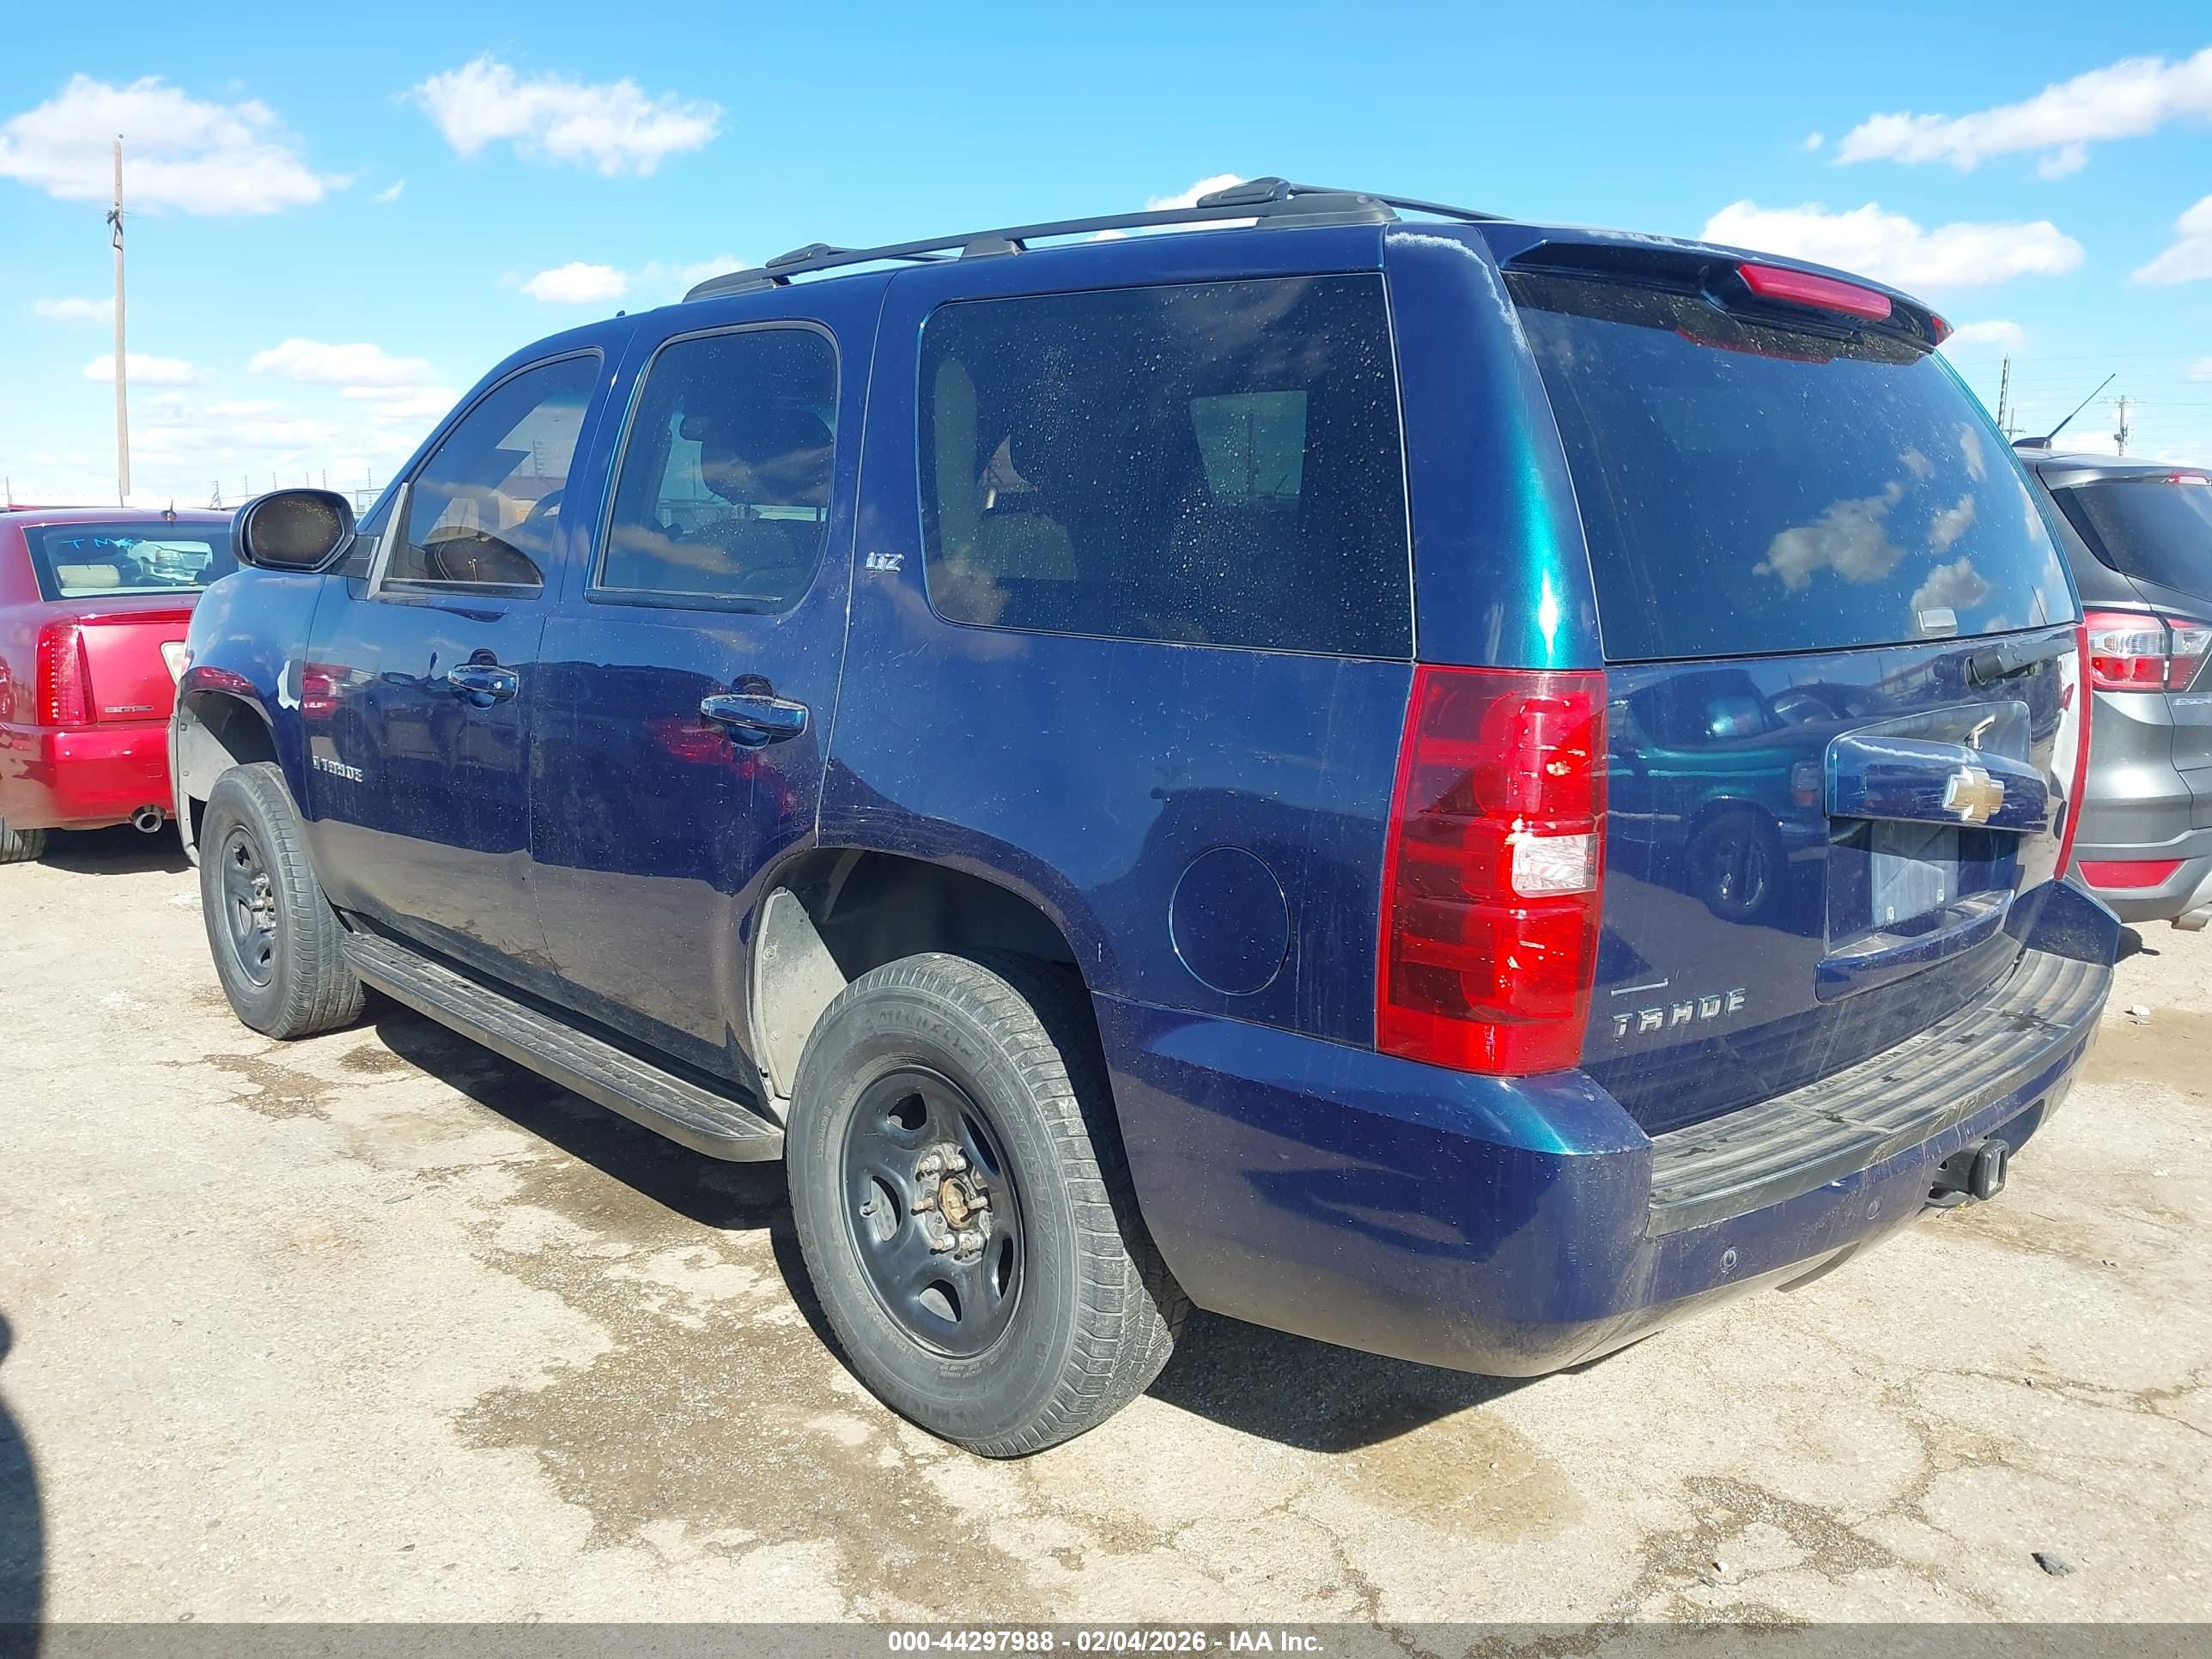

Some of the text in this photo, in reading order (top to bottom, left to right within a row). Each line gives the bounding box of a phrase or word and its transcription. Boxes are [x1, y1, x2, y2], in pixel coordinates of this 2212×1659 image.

[866, 551, 905, 573] LTZ
[320, 758, 364, 783] TAHOE
[1611, 988, 1747, 1040] TAHOE
